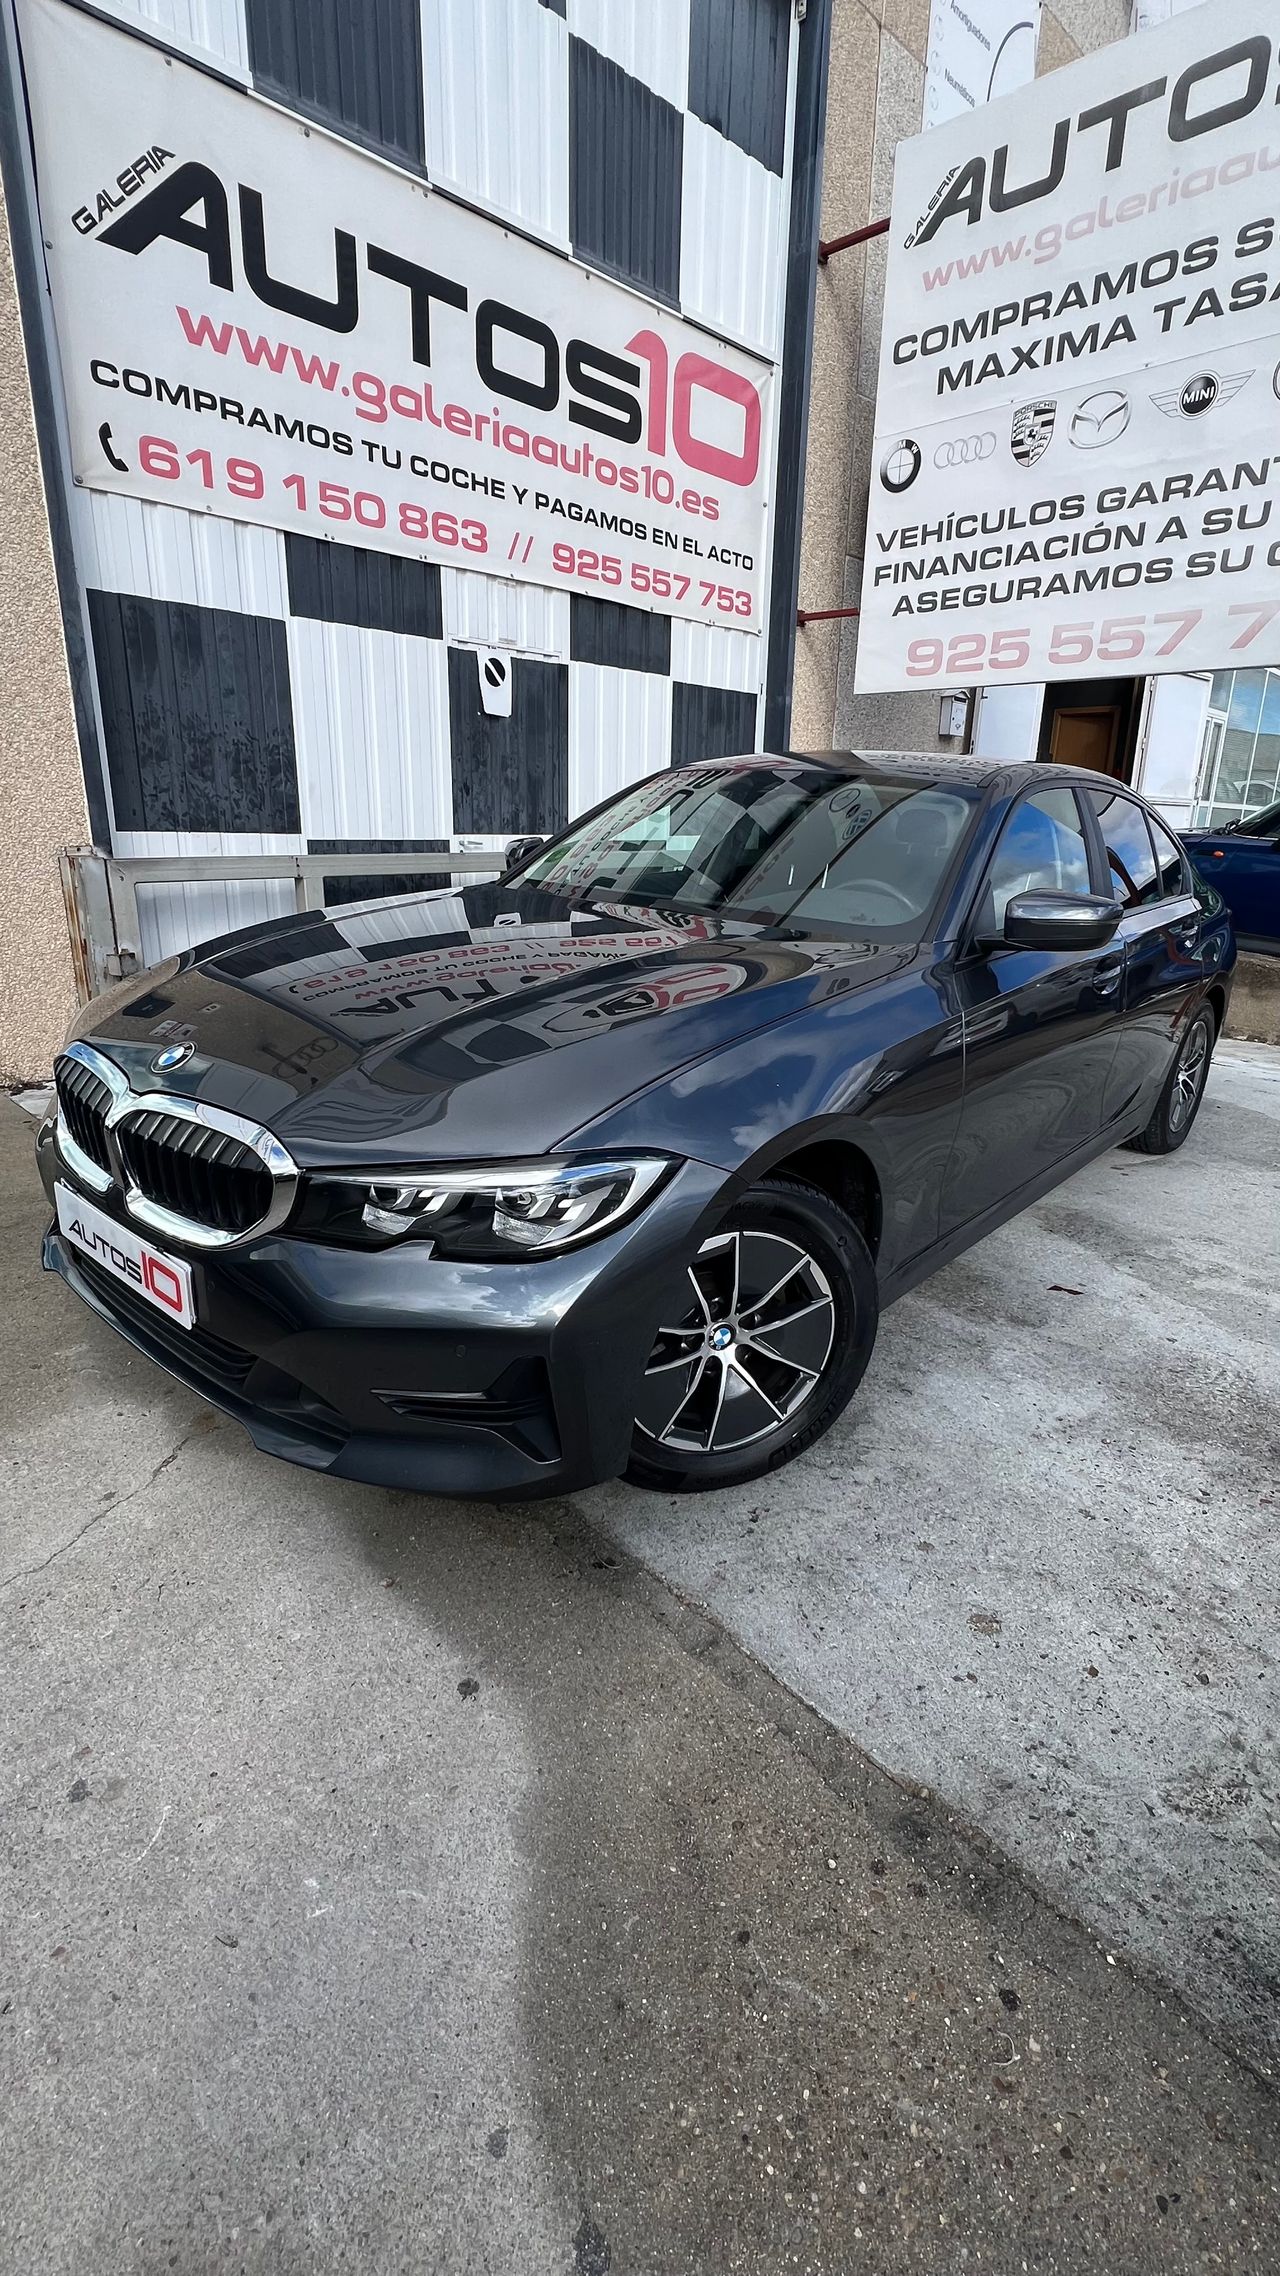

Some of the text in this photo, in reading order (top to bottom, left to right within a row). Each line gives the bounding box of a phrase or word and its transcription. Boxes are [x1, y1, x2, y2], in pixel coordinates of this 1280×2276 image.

[913, 35, 1280, 248] AUTO
[71, 146, 176, 235] GALERIA
[903, 165, 961, 250] GALERIA
[893, 235, 1220, 366] COMPRAMOS
[936, 314, 1137, 395] MAXIMA
[1183, 386, 1215, 405] MINI
[176, 305, 720, 521] www.galeriaautos10.es
[90, 359, 754, 571] COMPRAMOS TU COCHE Y PAGAMOS EN EL ACTO
[876, 456, 1280, 552] VEHÍCULOS GARAN
[138, 435, 265, 500] 619
[282, 474, 387, 529] 150
[399, 502, 489, 553] 863
[553, 542, 623, 586] 925
[631, 563, 691, 602] 557
[699, 580, 752, 617] 753
[874, 500, 1273, 588] FINANCIACIÓN A SU
[892, 558, 1173, 617] ASEGURAMOS
[1186, 545, 1255, 578] SU
[906, 628, 1031, 677] 925
[1048, 608, 1203, 665] 557
[69, 1219, 183, 1313] AUTOS10
